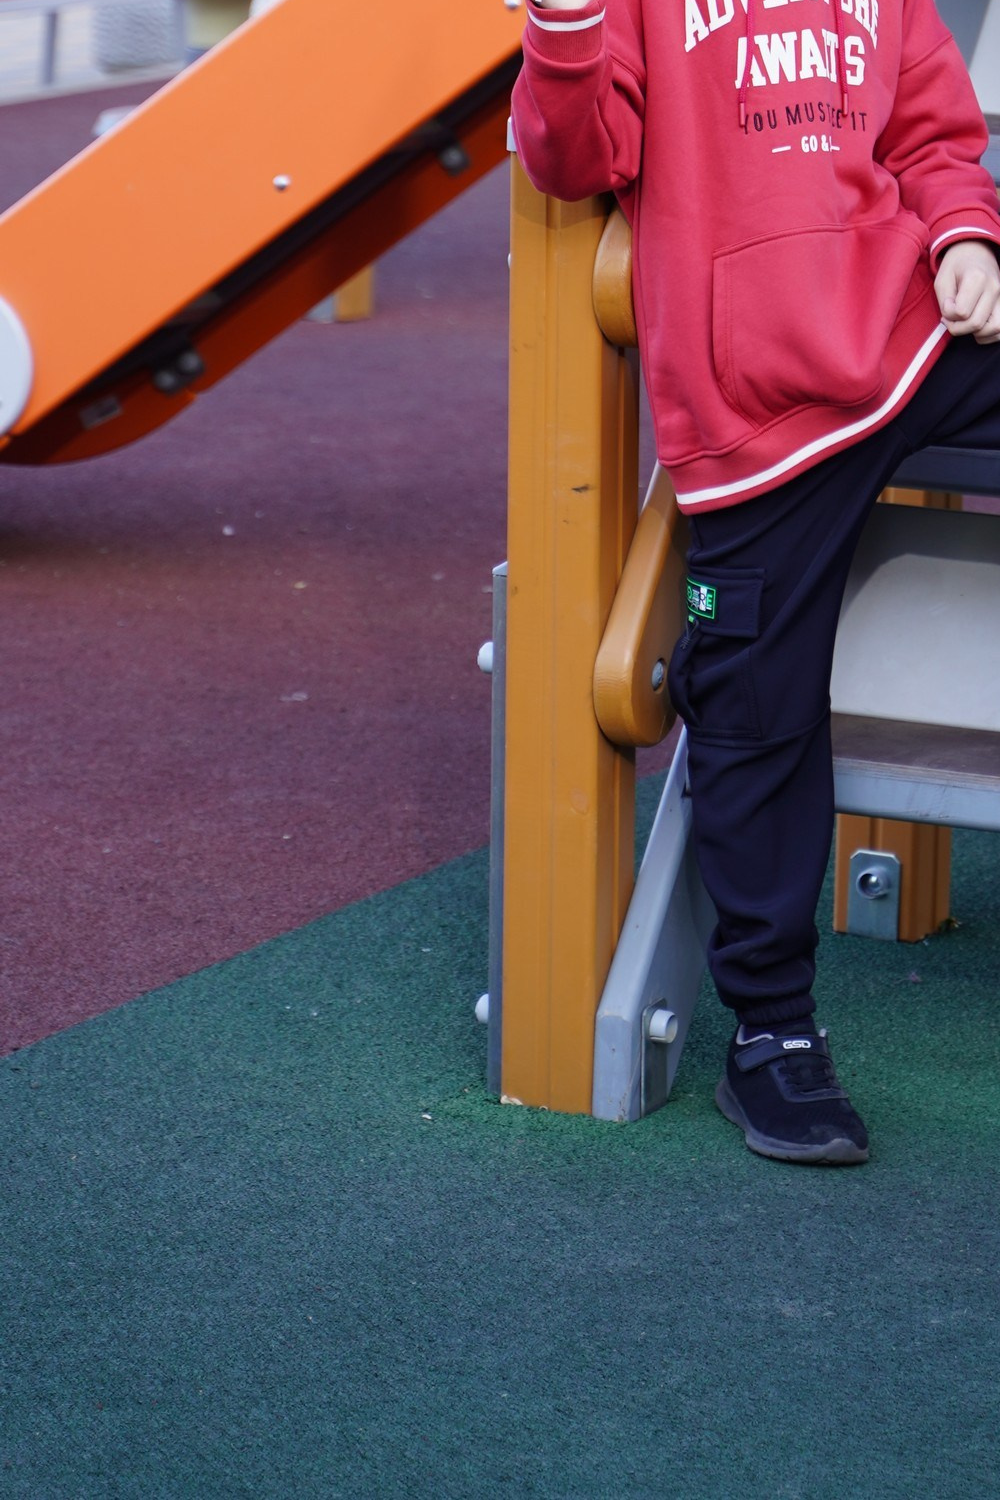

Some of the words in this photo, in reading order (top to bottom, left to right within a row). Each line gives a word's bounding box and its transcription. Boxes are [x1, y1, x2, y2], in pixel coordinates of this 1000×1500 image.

[735, 28, 865, 90] AWAITS
[743, 108, 778, 135] YOU
[851, 111, 867, 132] IT
[801, 134, 818, 153] GO
[782, 1040, 812, 1050] GSD
